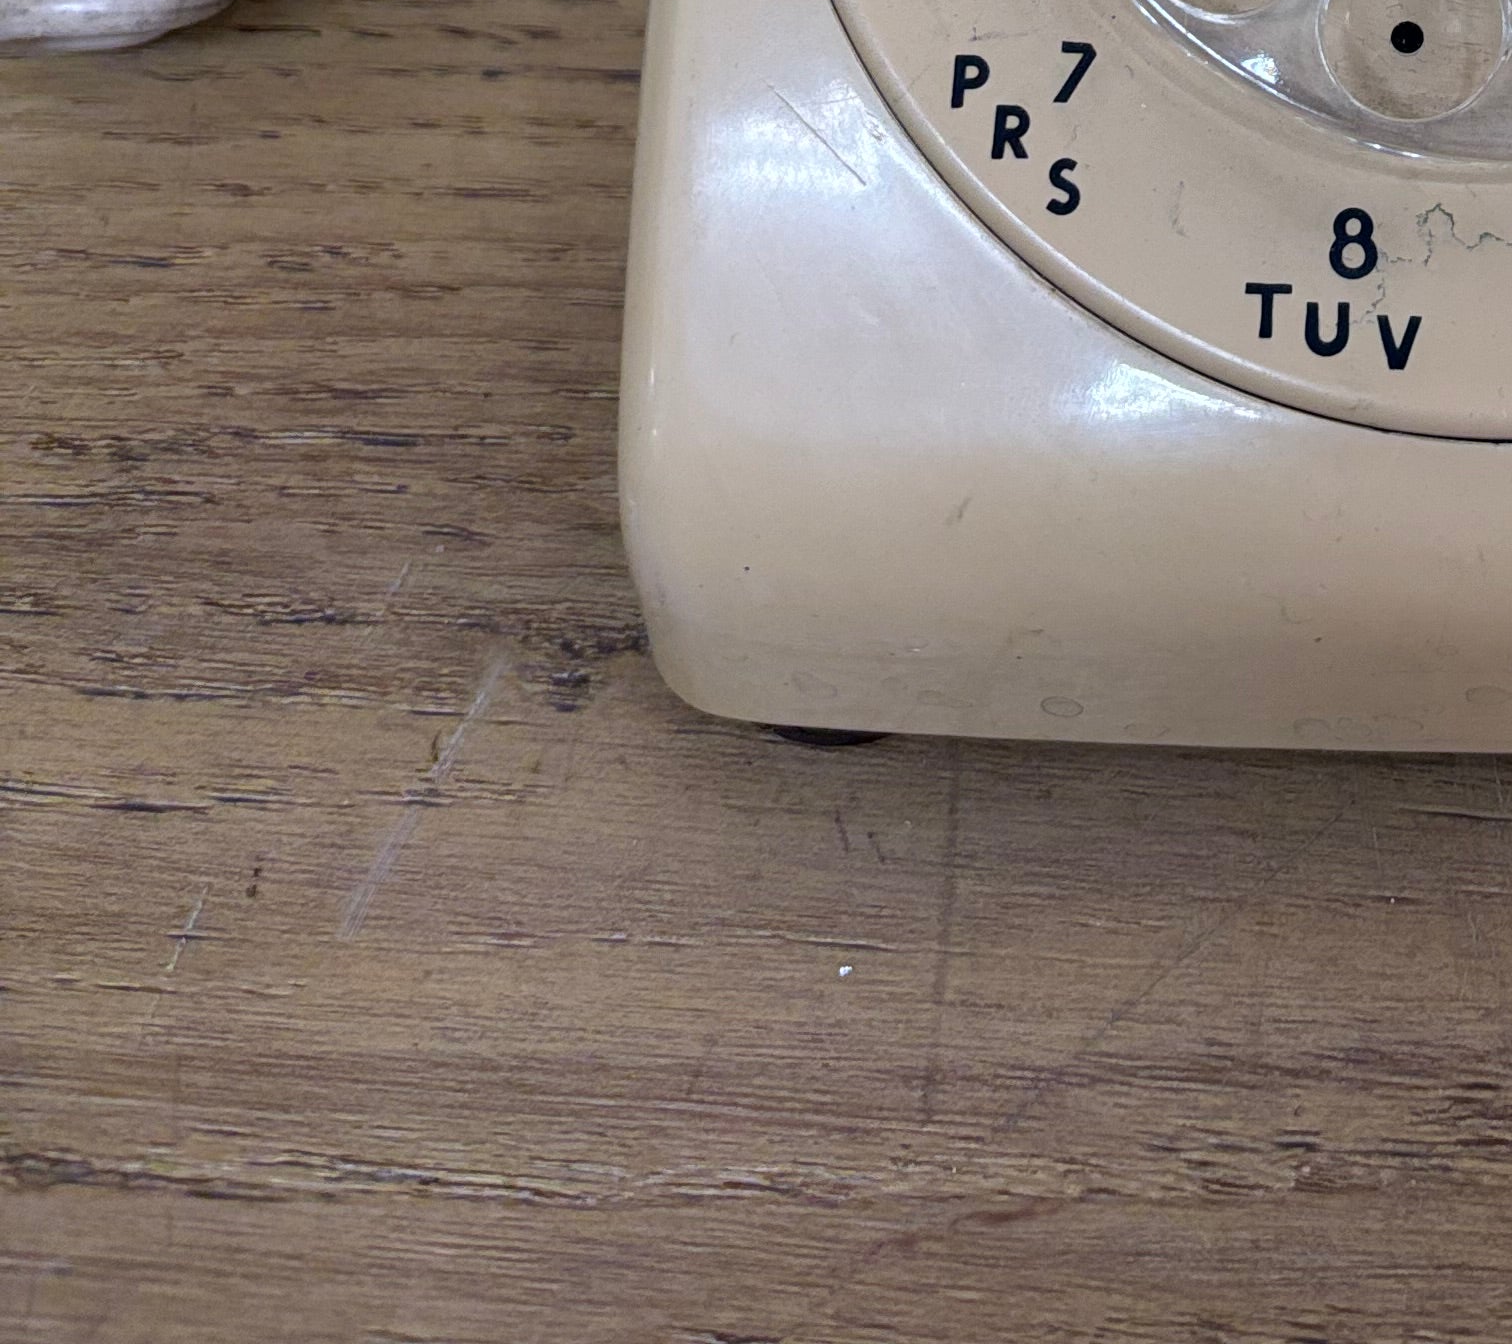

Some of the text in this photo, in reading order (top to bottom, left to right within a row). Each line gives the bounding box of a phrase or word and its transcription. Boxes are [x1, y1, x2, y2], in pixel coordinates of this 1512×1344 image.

[1051, 39, 1098, 105] 7
[1327, 206, 1380, 281] 8
[1243, 281, 1424, 372] TUV
